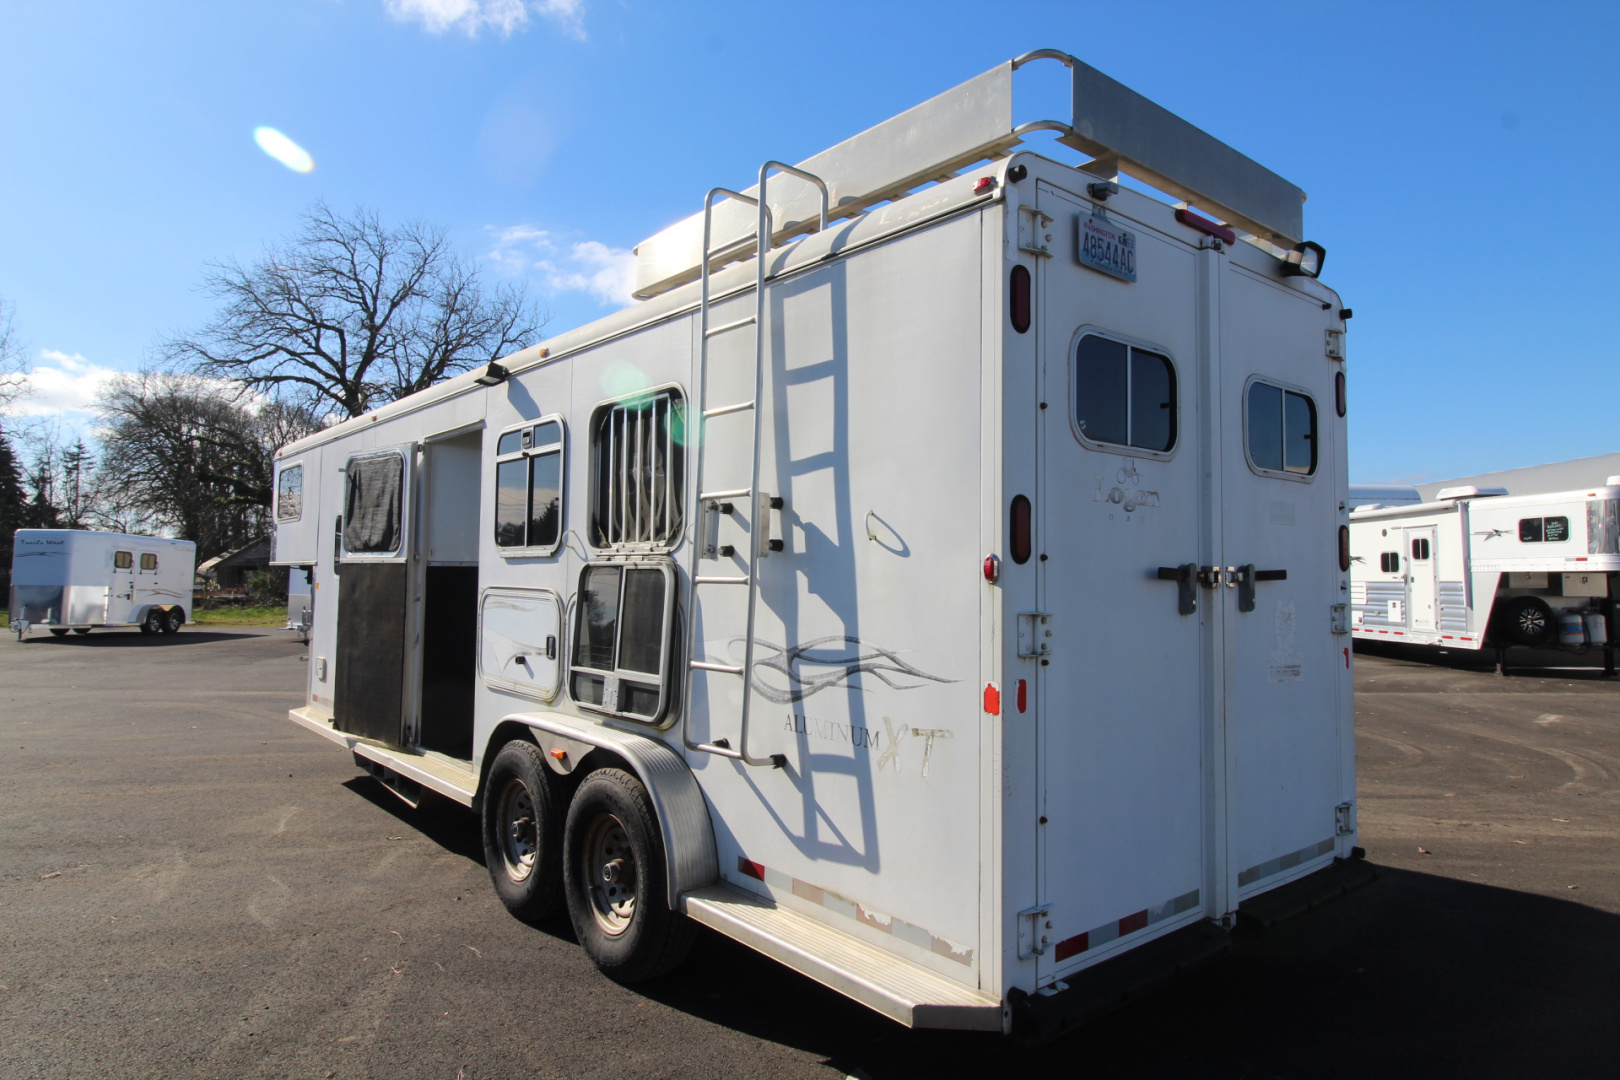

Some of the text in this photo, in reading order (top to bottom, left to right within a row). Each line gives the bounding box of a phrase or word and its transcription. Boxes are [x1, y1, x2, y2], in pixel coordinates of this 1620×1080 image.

[1083, 221, 1116, 241] WASHINGTON
[1083, 231, 1134, 274] 48544AC
[784, 713, 880, 750] ALUMINUM
